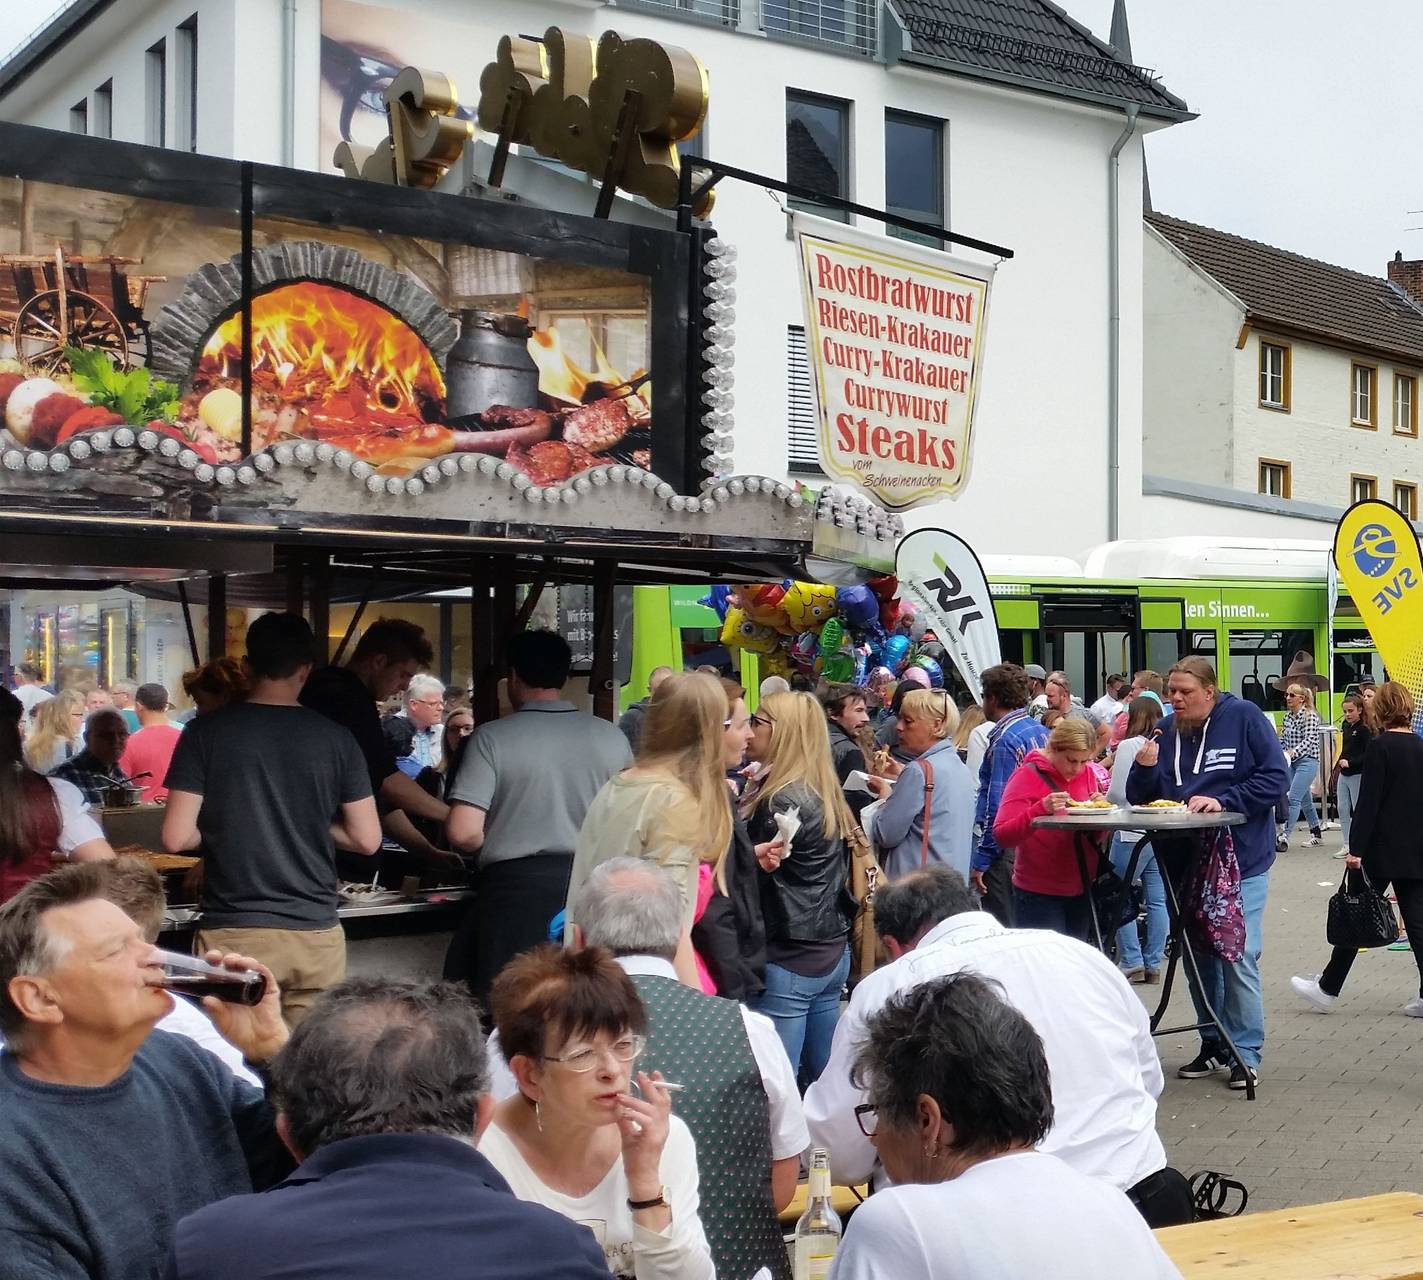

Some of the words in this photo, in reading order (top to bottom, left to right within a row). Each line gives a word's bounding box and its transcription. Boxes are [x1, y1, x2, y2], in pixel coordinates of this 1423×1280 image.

[816, 253, 974, 324] Rostbratwurst
[818, 297, 972, 359] Riesen-Krakauer
[823, 336, 968, 394] Curry-Krakauer
[844, 378, 948, 425] Currywurst
[836, 412, 956, 471] Steaks
[852, 459, 873, 471] vom
[862, 473, 943, 488] Schweinenacken
[1209, 600, 1270, 618] Sinnen...
